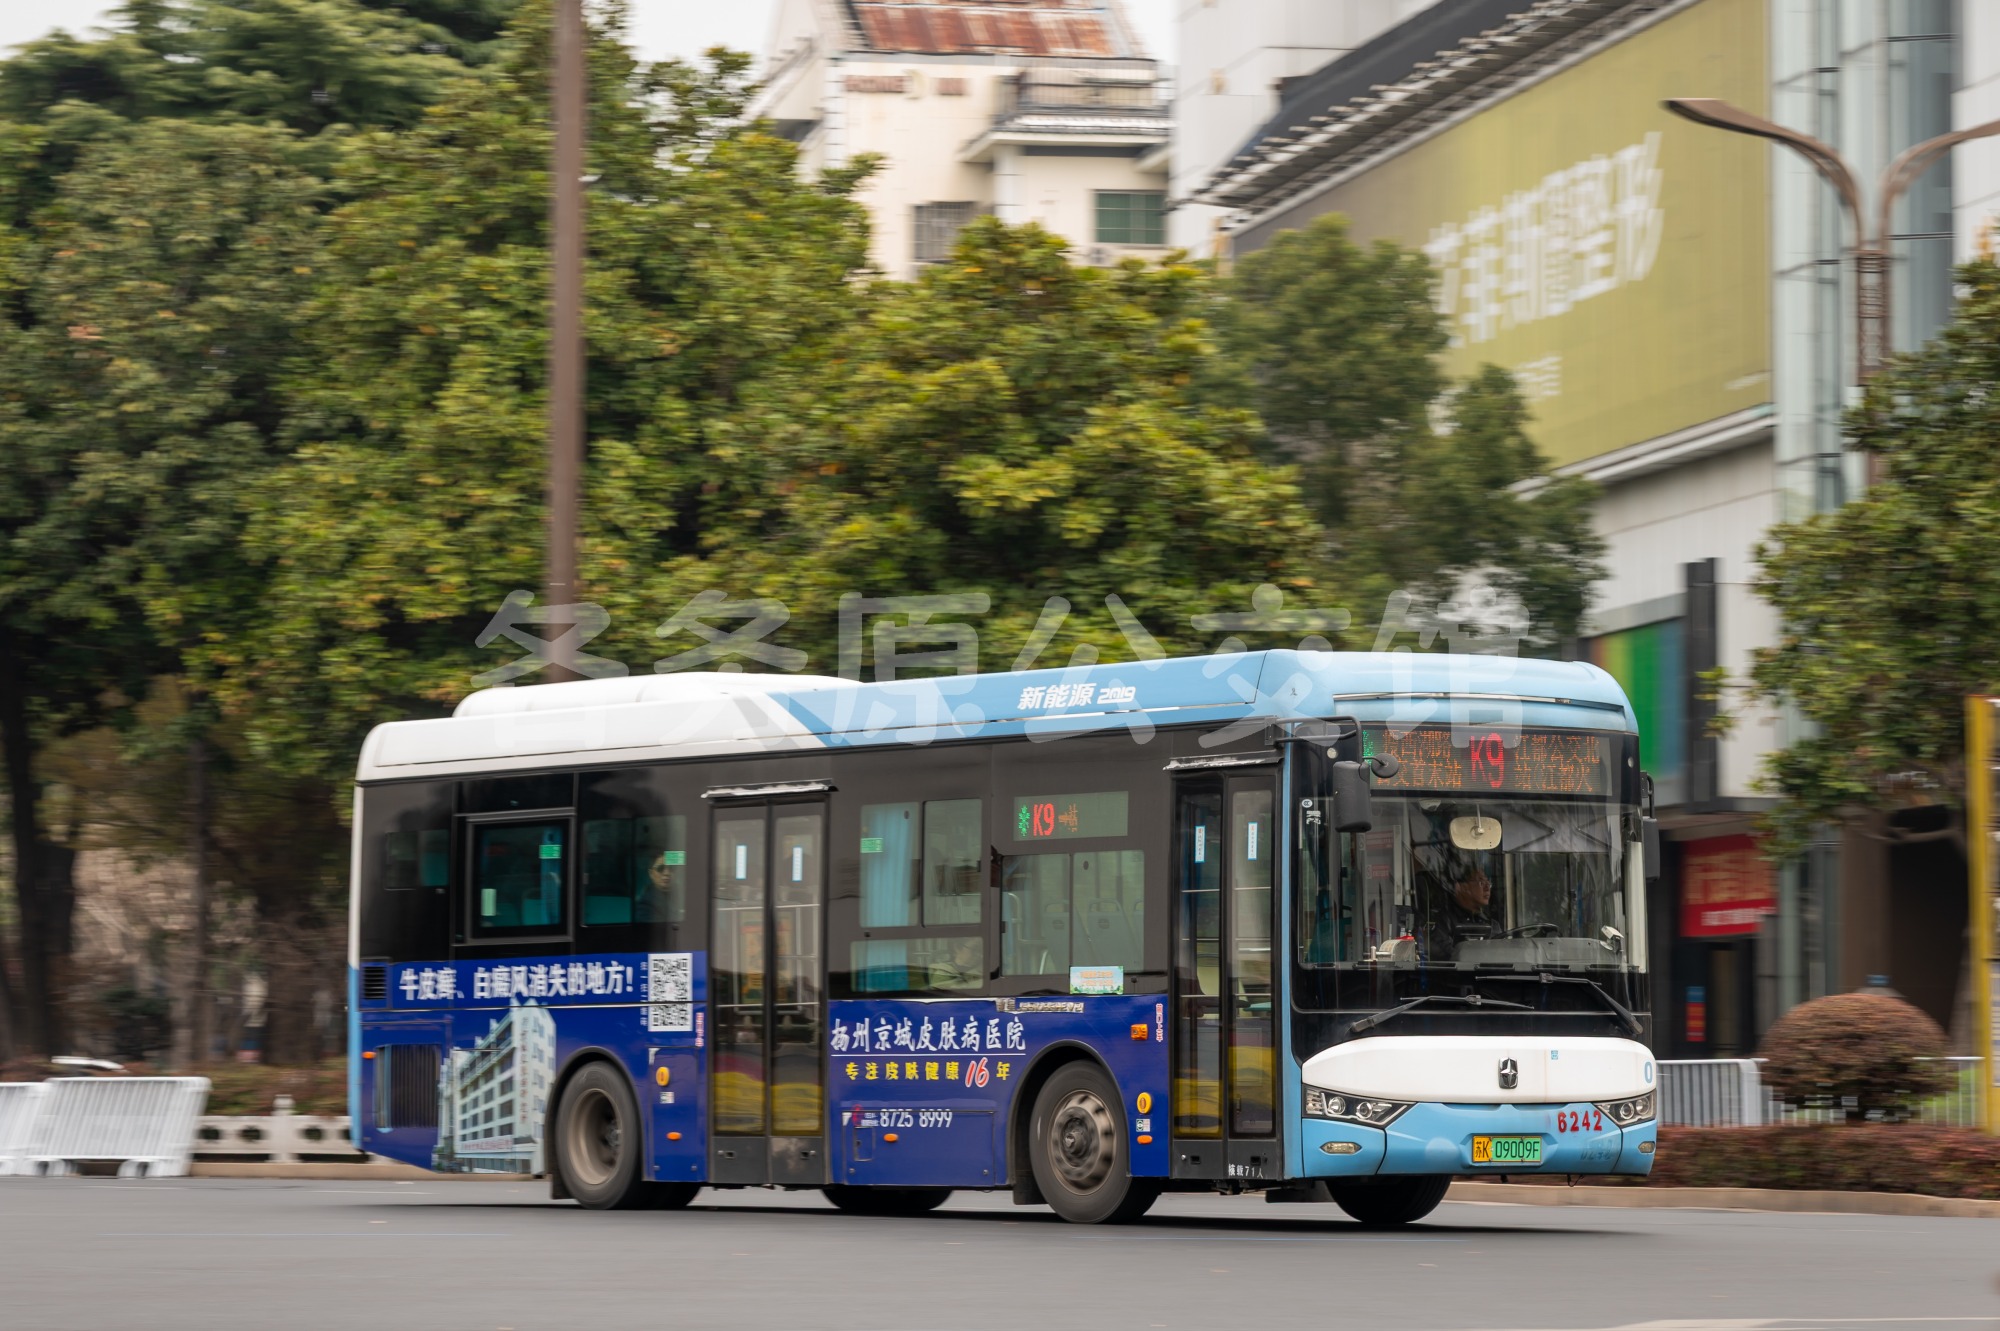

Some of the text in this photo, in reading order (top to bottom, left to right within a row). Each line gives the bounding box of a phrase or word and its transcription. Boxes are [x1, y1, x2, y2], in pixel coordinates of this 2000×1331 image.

[1017, 683, 1137, 710] 新能源 2019
[1377, 759, 1462, 787] 交首末站
[1470, 733, 1504, 788] K9
[1033, 803, 1055, 836] K9
[830, 1015, 1026, 1052] 扬州京城皮肤病医院
[880, 1108, 914, 1128] 8725
[919, 1108, 953, 1128] 8999
[1557, 1111, 1602, 1133] 6242
